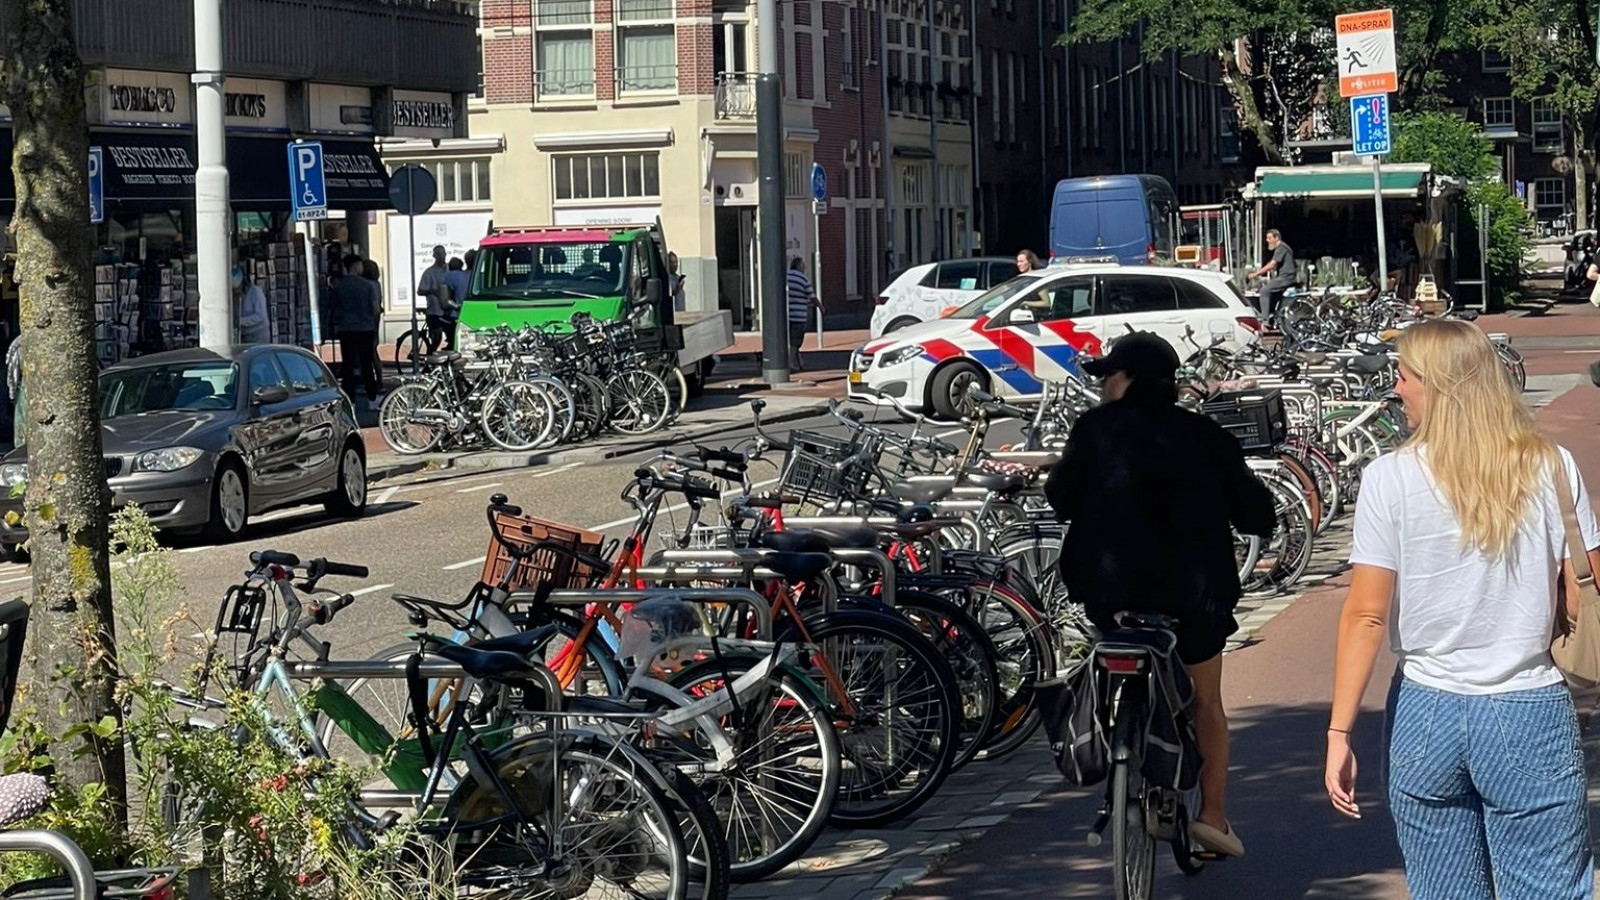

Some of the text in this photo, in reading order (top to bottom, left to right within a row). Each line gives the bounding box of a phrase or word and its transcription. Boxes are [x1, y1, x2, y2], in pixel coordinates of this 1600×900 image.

[1340, 19, 1388, 32] DNA-SPRAY
[1357, 141, 1387, 151] LET OP
[108, 146, 194, 168] BESTSELLER
[298, 148, 316, 181] P
[324, 154, 378, 173] STSELLER
